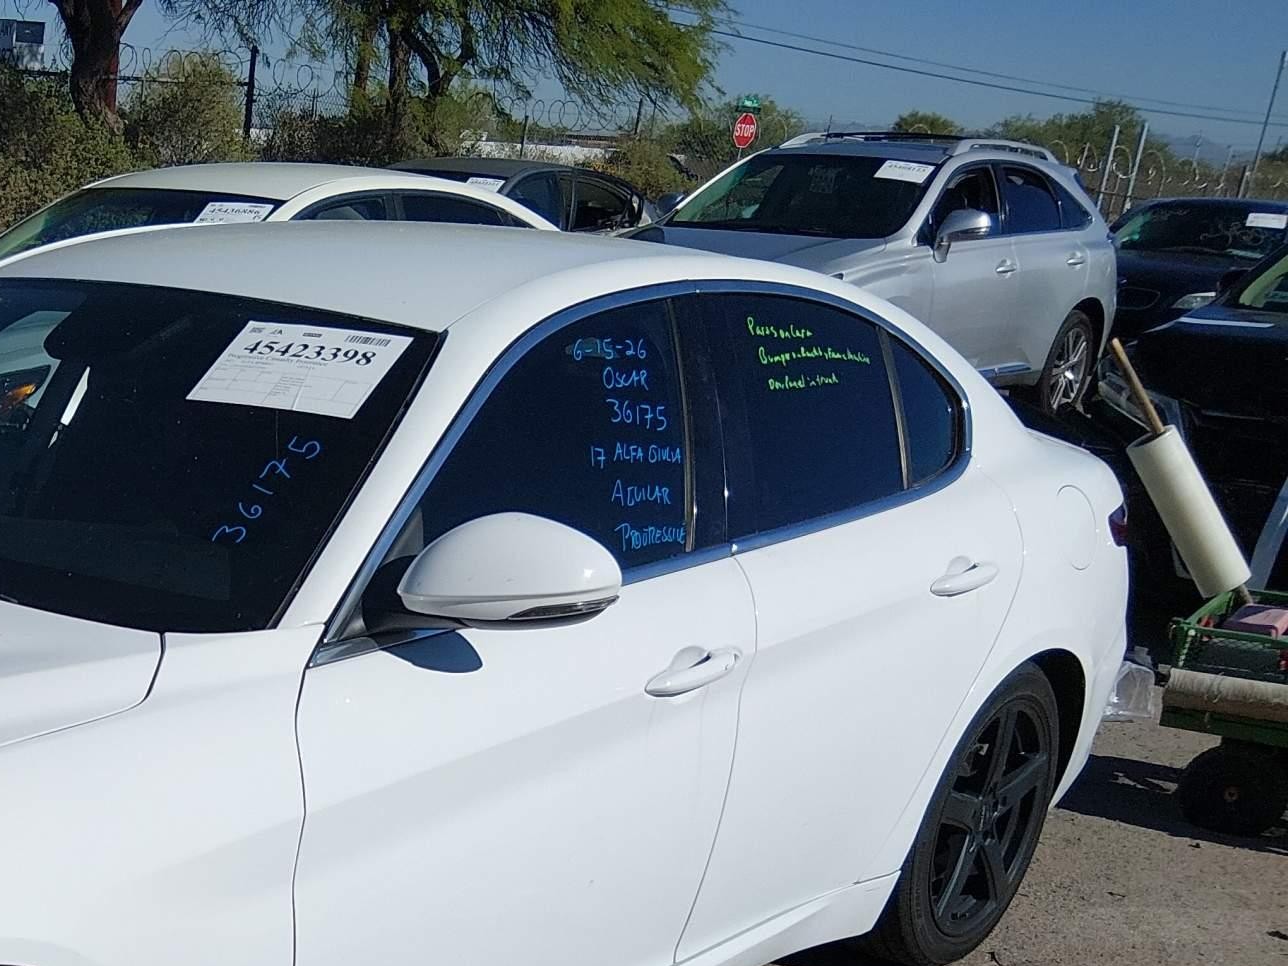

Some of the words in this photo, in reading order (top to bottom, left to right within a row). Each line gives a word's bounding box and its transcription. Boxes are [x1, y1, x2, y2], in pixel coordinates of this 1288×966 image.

[735, 123, 754, 137] STOP
[243, 339, 377, 367] 45423398
[573, 338, 647, 361] 6-15-26
[605, 398, 668, 431] 36175
[590, 446, 606, 469] 17
[613, 442, 644, 464] ALFA
[211, 435, 322, 544] 36175
